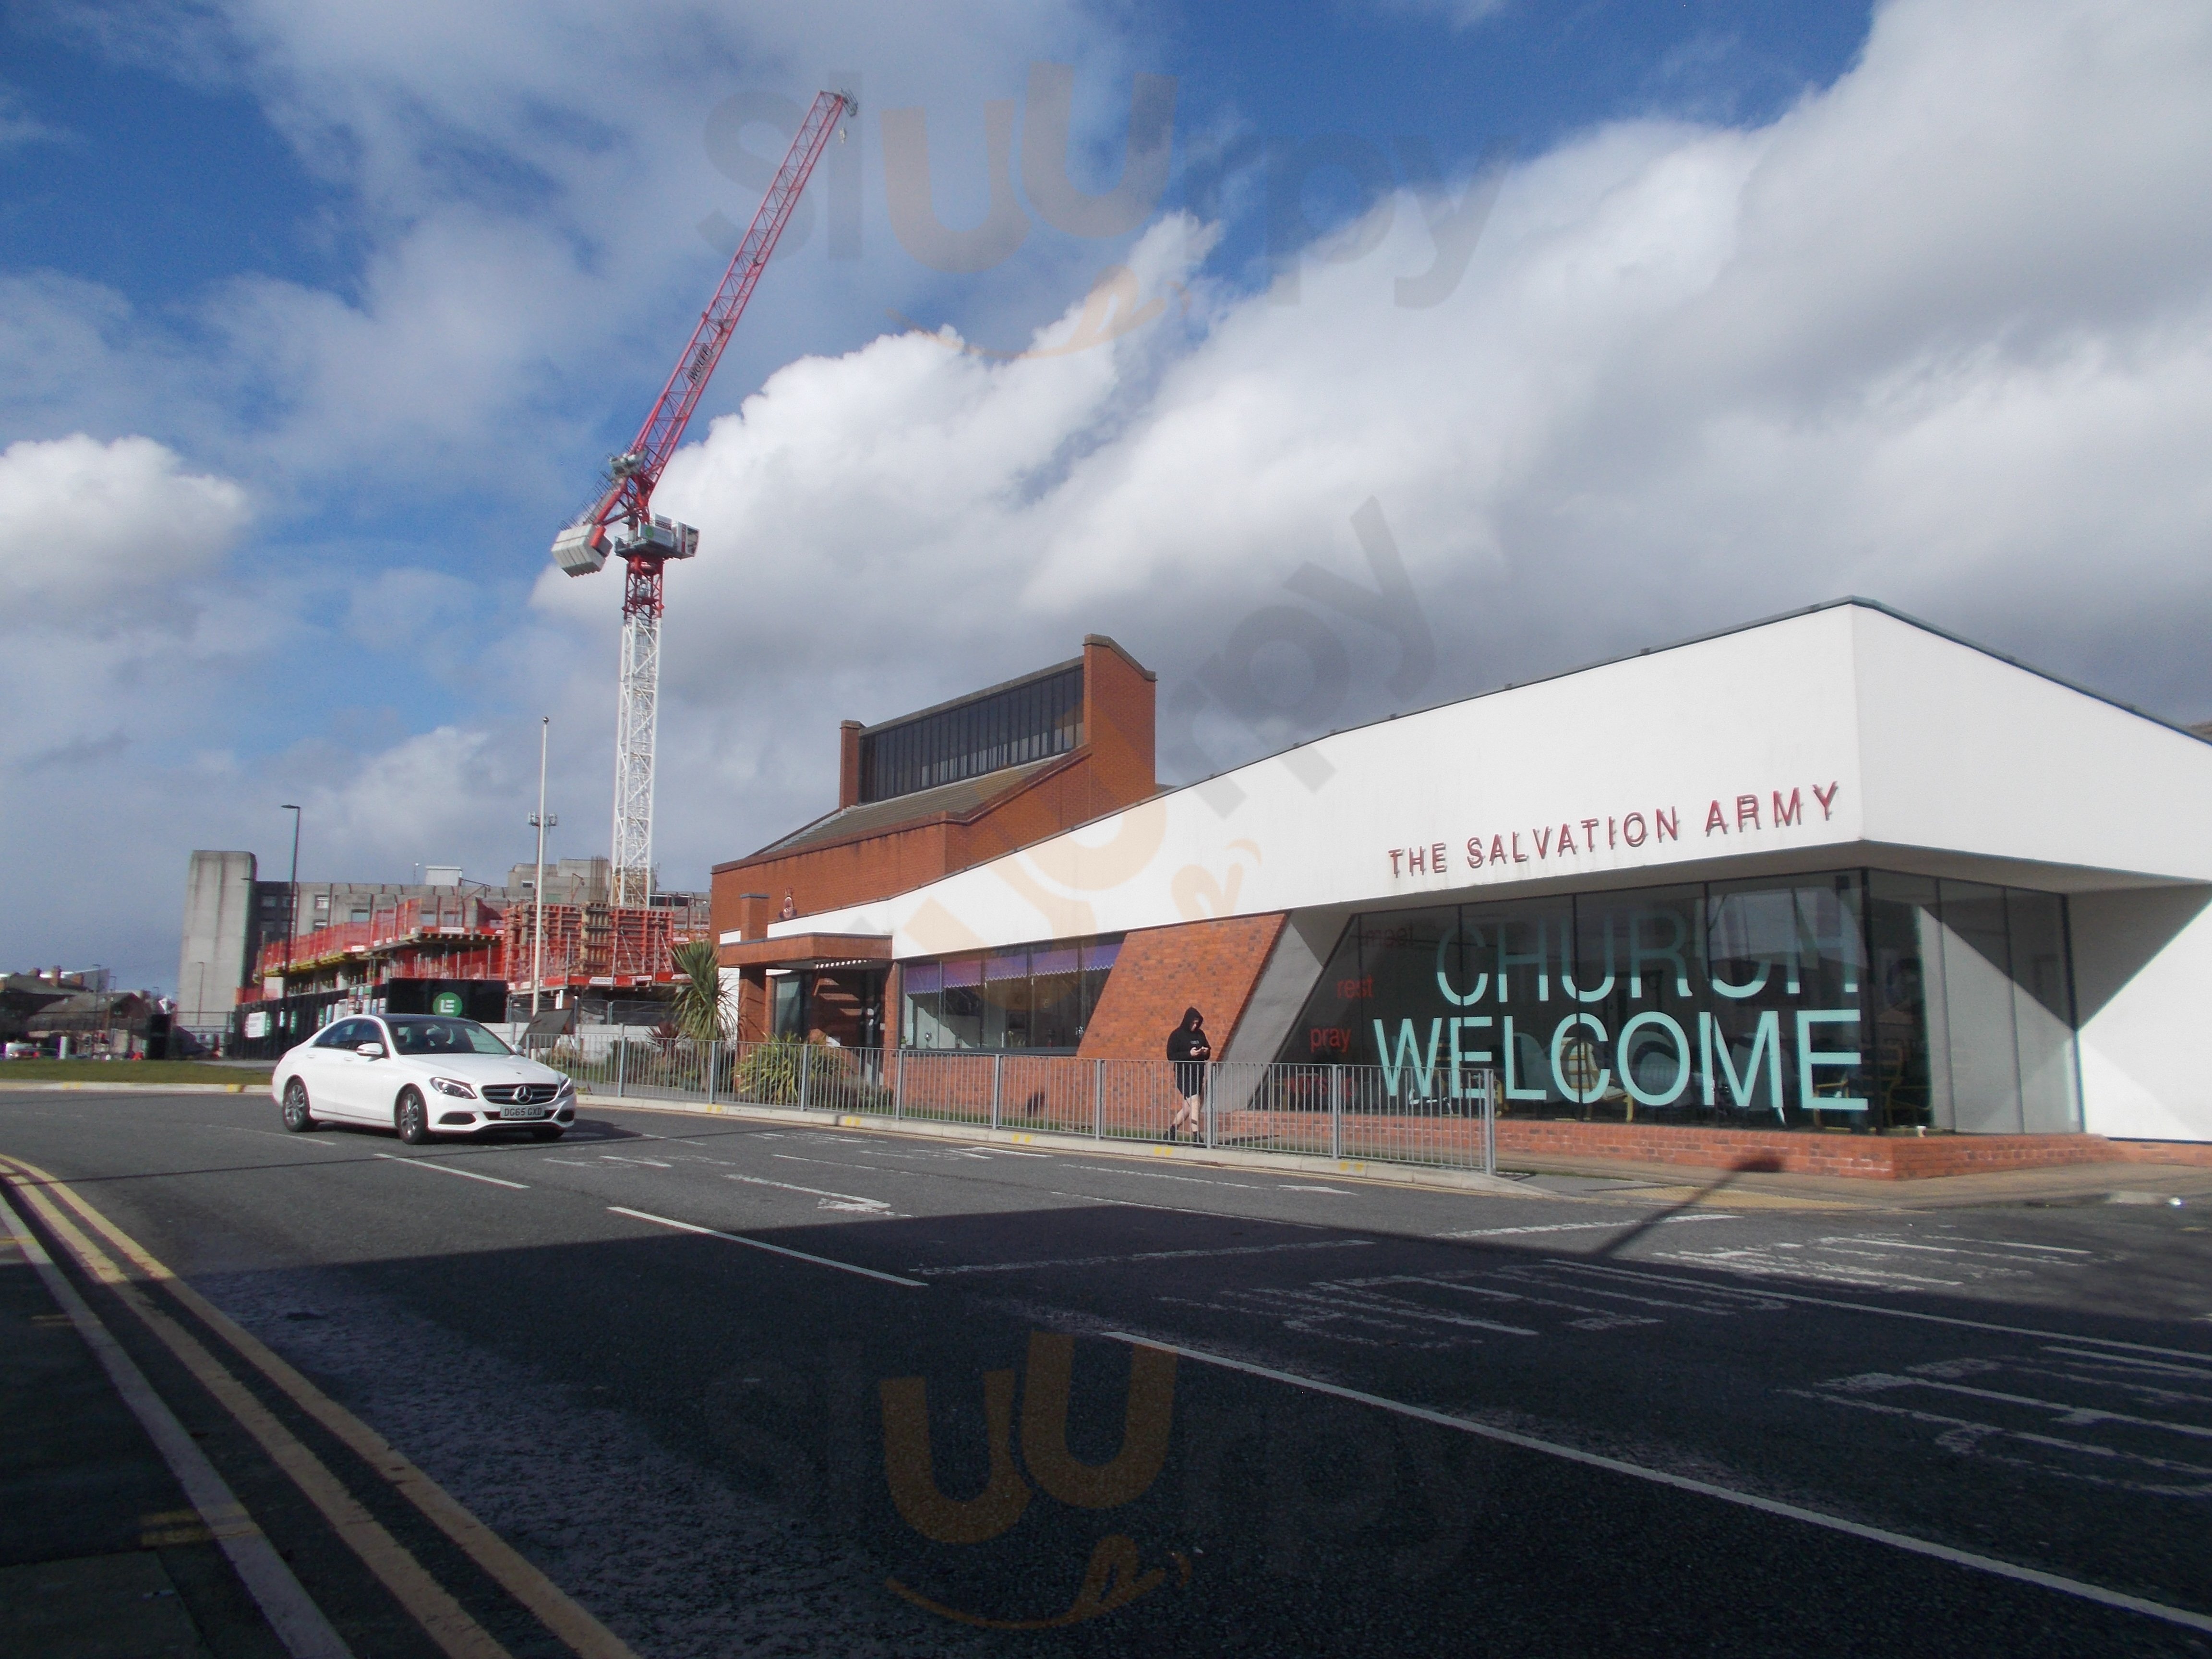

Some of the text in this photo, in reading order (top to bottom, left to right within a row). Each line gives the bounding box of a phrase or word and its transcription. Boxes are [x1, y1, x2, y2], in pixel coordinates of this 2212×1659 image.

[1388, 781, 1839, 878] THE SALVATION ARMY
[1436, 898, 1859, 1006] CHURCH
[1337, 974, 1373, 999] rest
[1310, 1025, 1352, 1053] pray
[1373, 1010, 1869, 1111] WELCOME
[504, 1107, 526, 1117] DG65
